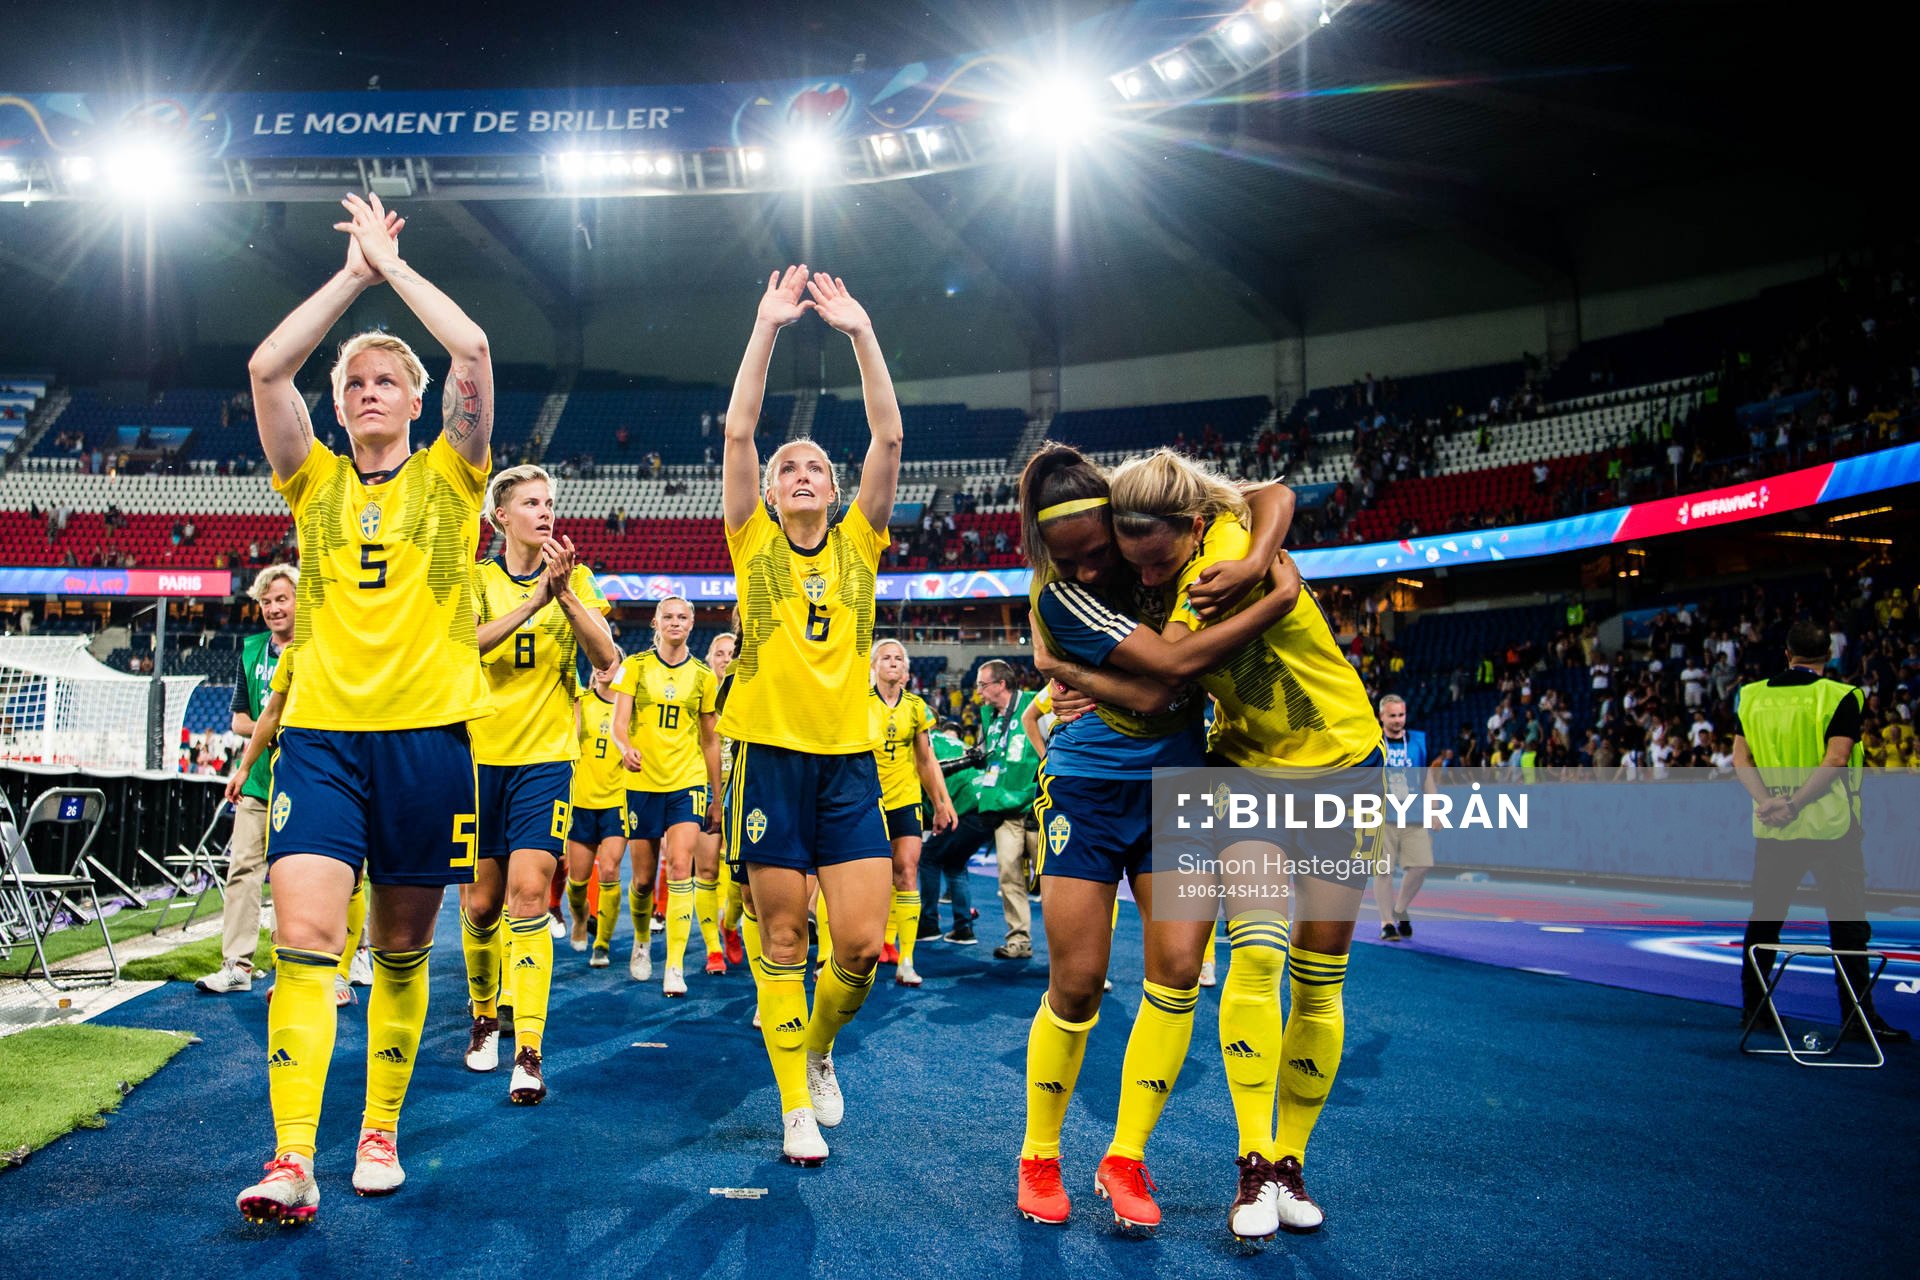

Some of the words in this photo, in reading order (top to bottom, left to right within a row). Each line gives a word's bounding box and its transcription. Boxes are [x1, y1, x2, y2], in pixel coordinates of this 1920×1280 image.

[253, 113, 295, 135] LE
[304, 112, 465, 135] MOMENT
[473, 111, 519, 133] DE
[359, 544, 387, 589] 5
[158, 575, 202, 591] PARIS
[701, 580, 721, 595] LE
[805, 602, 831, 641] 6
[515, 633, 535, 668] 8
[657, 703, 680, 729] 18
[595, 738, 607, 758] 9
[884, 740, 896, 760] 4
[66, 805, 77, 817] 26
[689, 790, 706, 818] 18
[550, 799, 569, 840] 8
[450, 813, 475, 867] 5
